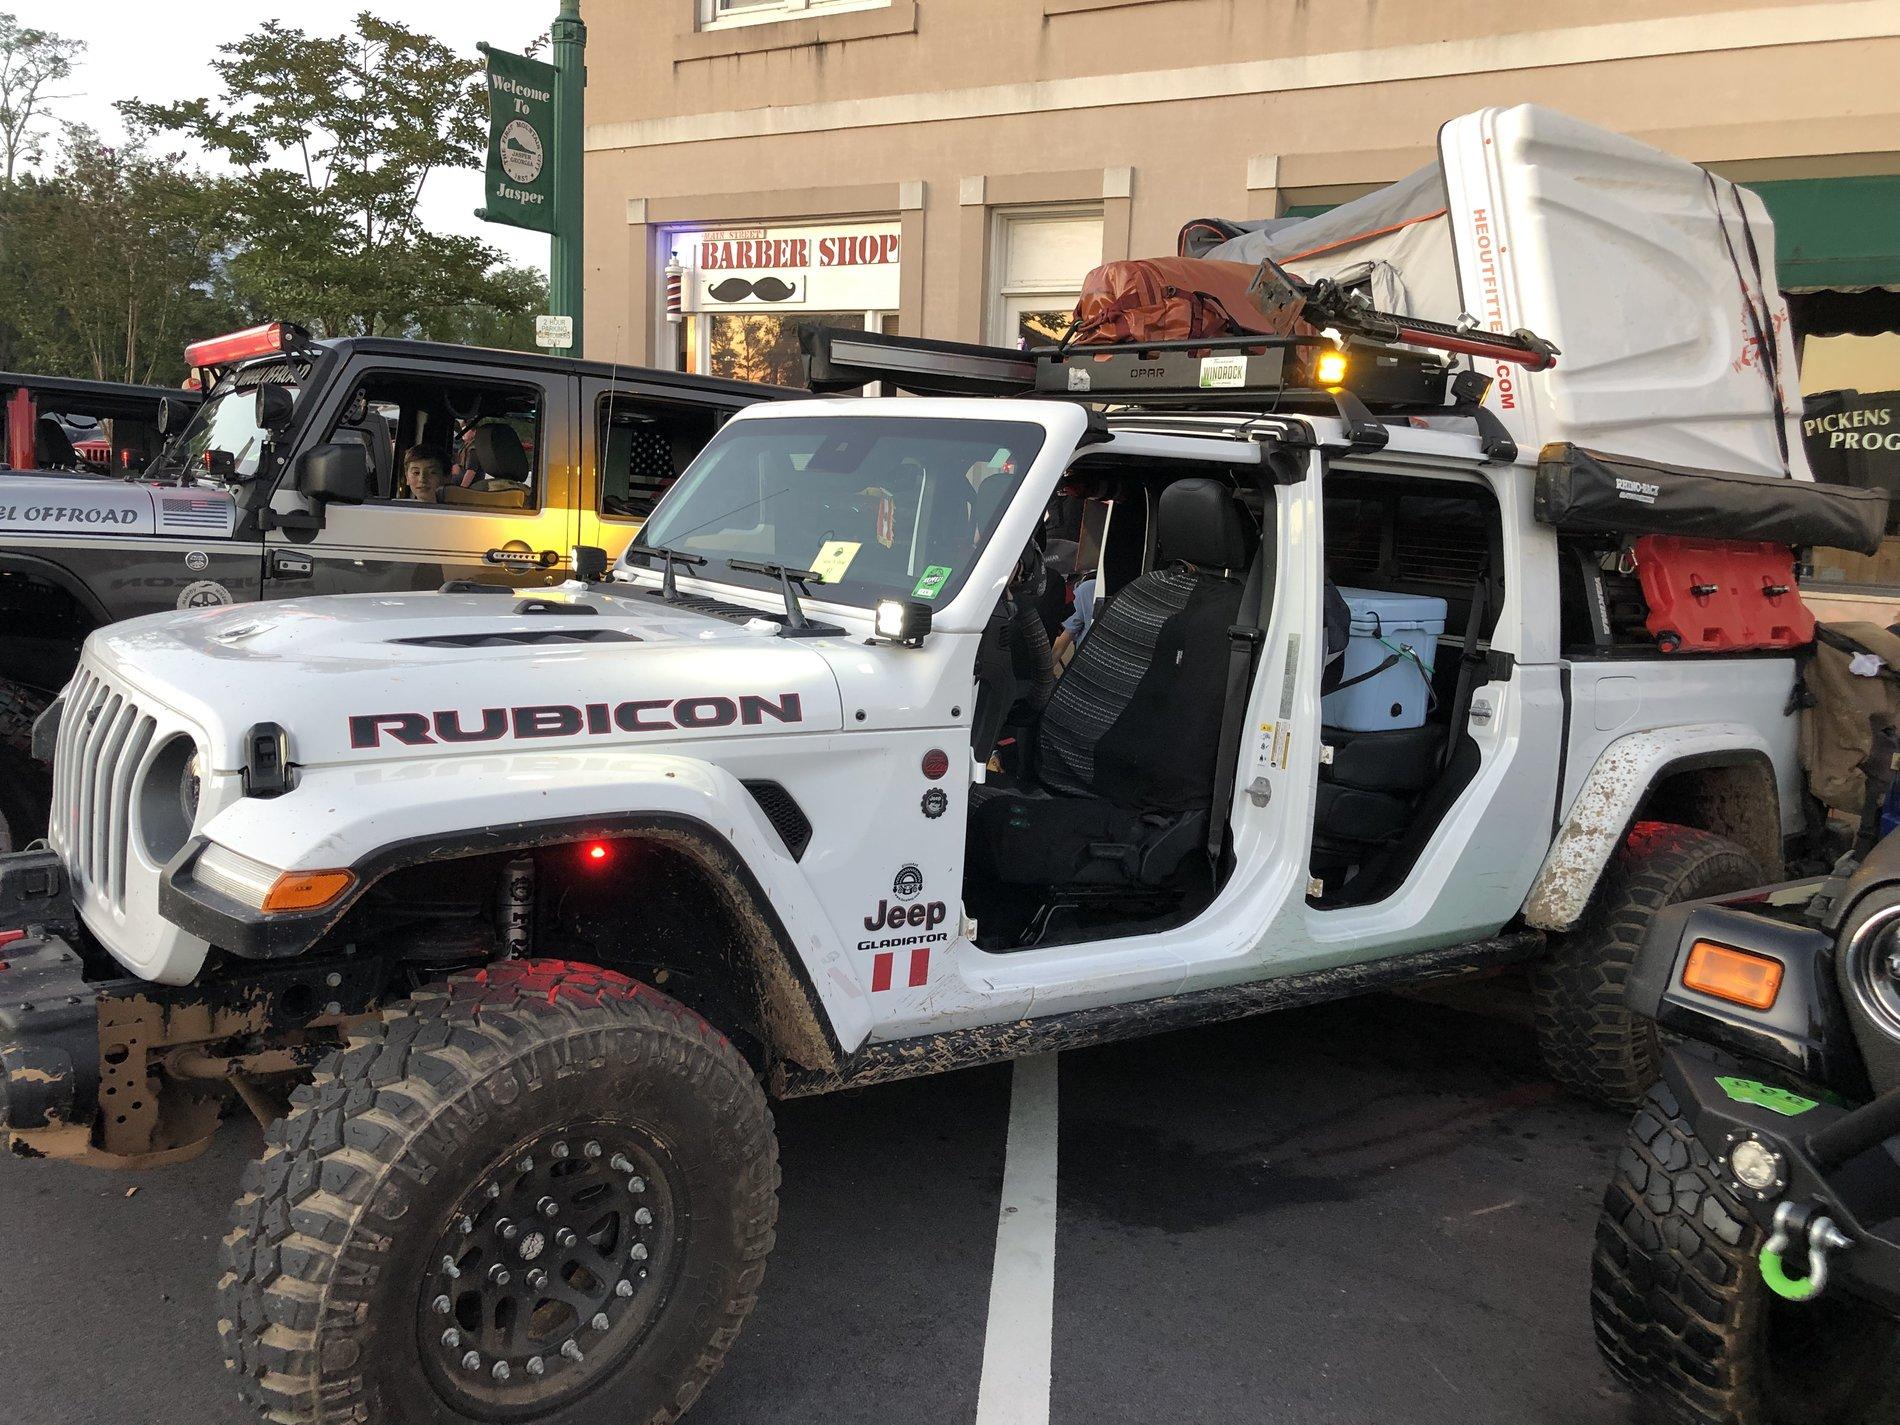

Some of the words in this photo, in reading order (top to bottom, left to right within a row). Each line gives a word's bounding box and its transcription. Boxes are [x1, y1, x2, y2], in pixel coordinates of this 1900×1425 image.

[492, 74, 550, 103] Welcome
[513, 98, 530, 115] To
[502, 124, 514, 144] FIRST
[516, 121, 541, 150] MOUNTAIN
[511, 151, 532, 160] JASPER
[496, 183, 544, 205] Jasper
[704, 232, 724, 240] MAIN
[730, 230, 761, 239] STREET
[701, 238, 809, 269] BARBER
[819, 234, 898, 266] SHOP
[1203, 366, 1243, 380] WINDROCK
[1803, 408, 1891, 437] PICKENS
[1829, 432, 1900, 451] PROG
[23, 507, 138, 524] OFFROAD
[348, 693, 802, 749] RUBICON
[863, 899, 947, 932] Jeep
[857, 932, 948, 951] GLADIATOR
